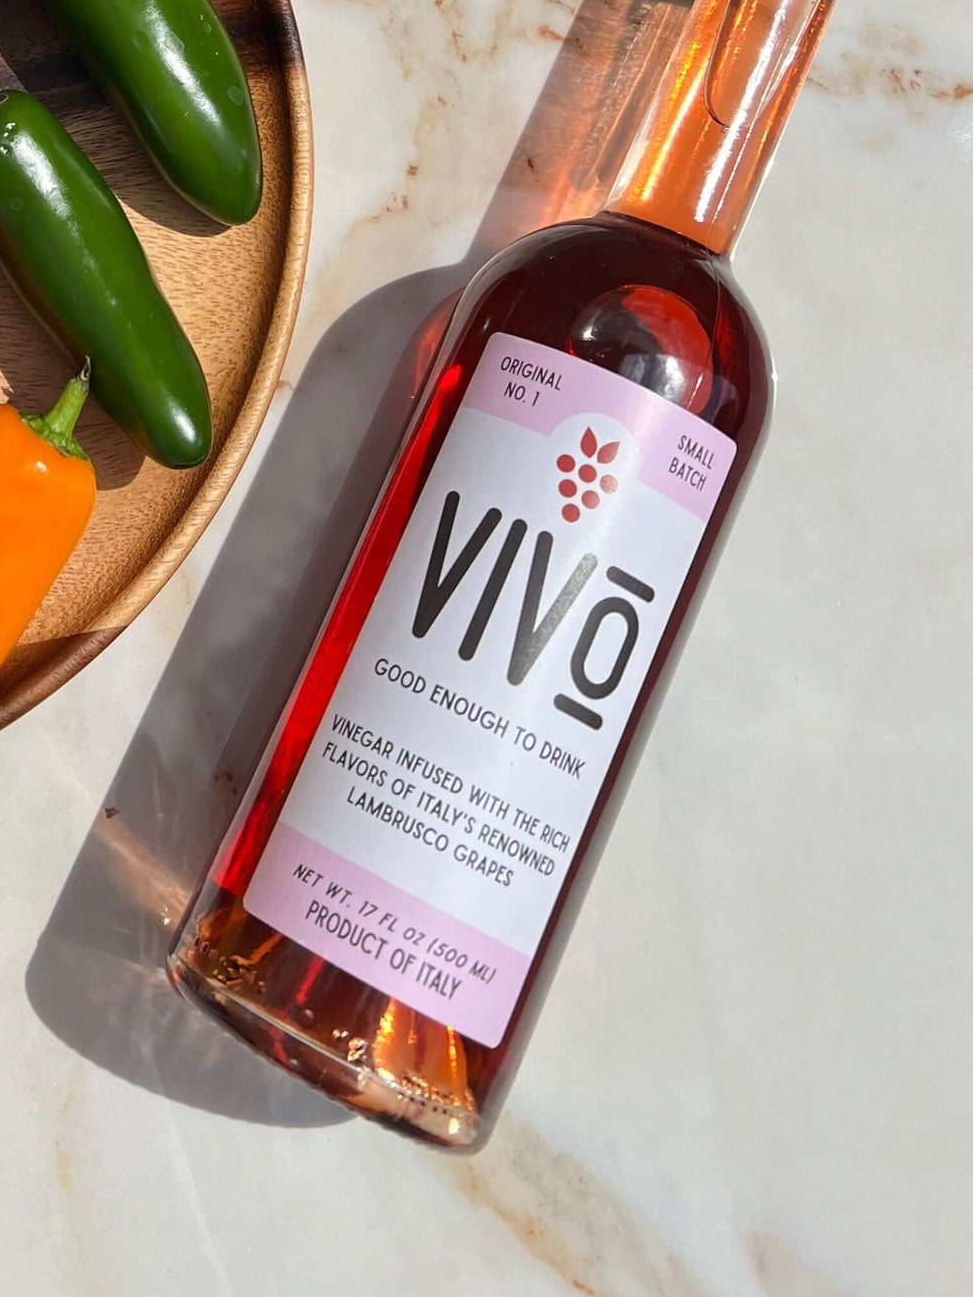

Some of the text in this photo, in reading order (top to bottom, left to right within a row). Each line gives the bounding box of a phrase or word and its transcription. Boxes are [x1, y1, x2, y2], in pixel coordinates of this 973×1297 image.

[501, 357, 563, 391] ORIGINAL
[504, 382, 540, 407] NO. 1
[669, 458, 707, 492] BATCH
[678, 435, 716, 470] SMALL
[374, 658, 587, 779] GOOD ENOUGH TO DRINK
[322, 742, 555, 877] FLAVORS OF ITALY'S RENOWNED
[332, 714, 571, 853] VINEGAR INFUSED WITH THE RICH
[346, 786, 514, 887] LAMBRUSCO GRAPES
[293, 864, 324, 888] NET
[326, 881, 352, 908] WT.
[359, 901, 379, 920] 17
[378, 912, 396, 932] FL
[427, 938, 468, 968] (500
[469, 959, 497, 984] ML)
[306, 900, 462, 1000] PRODUCT OF ITALY
